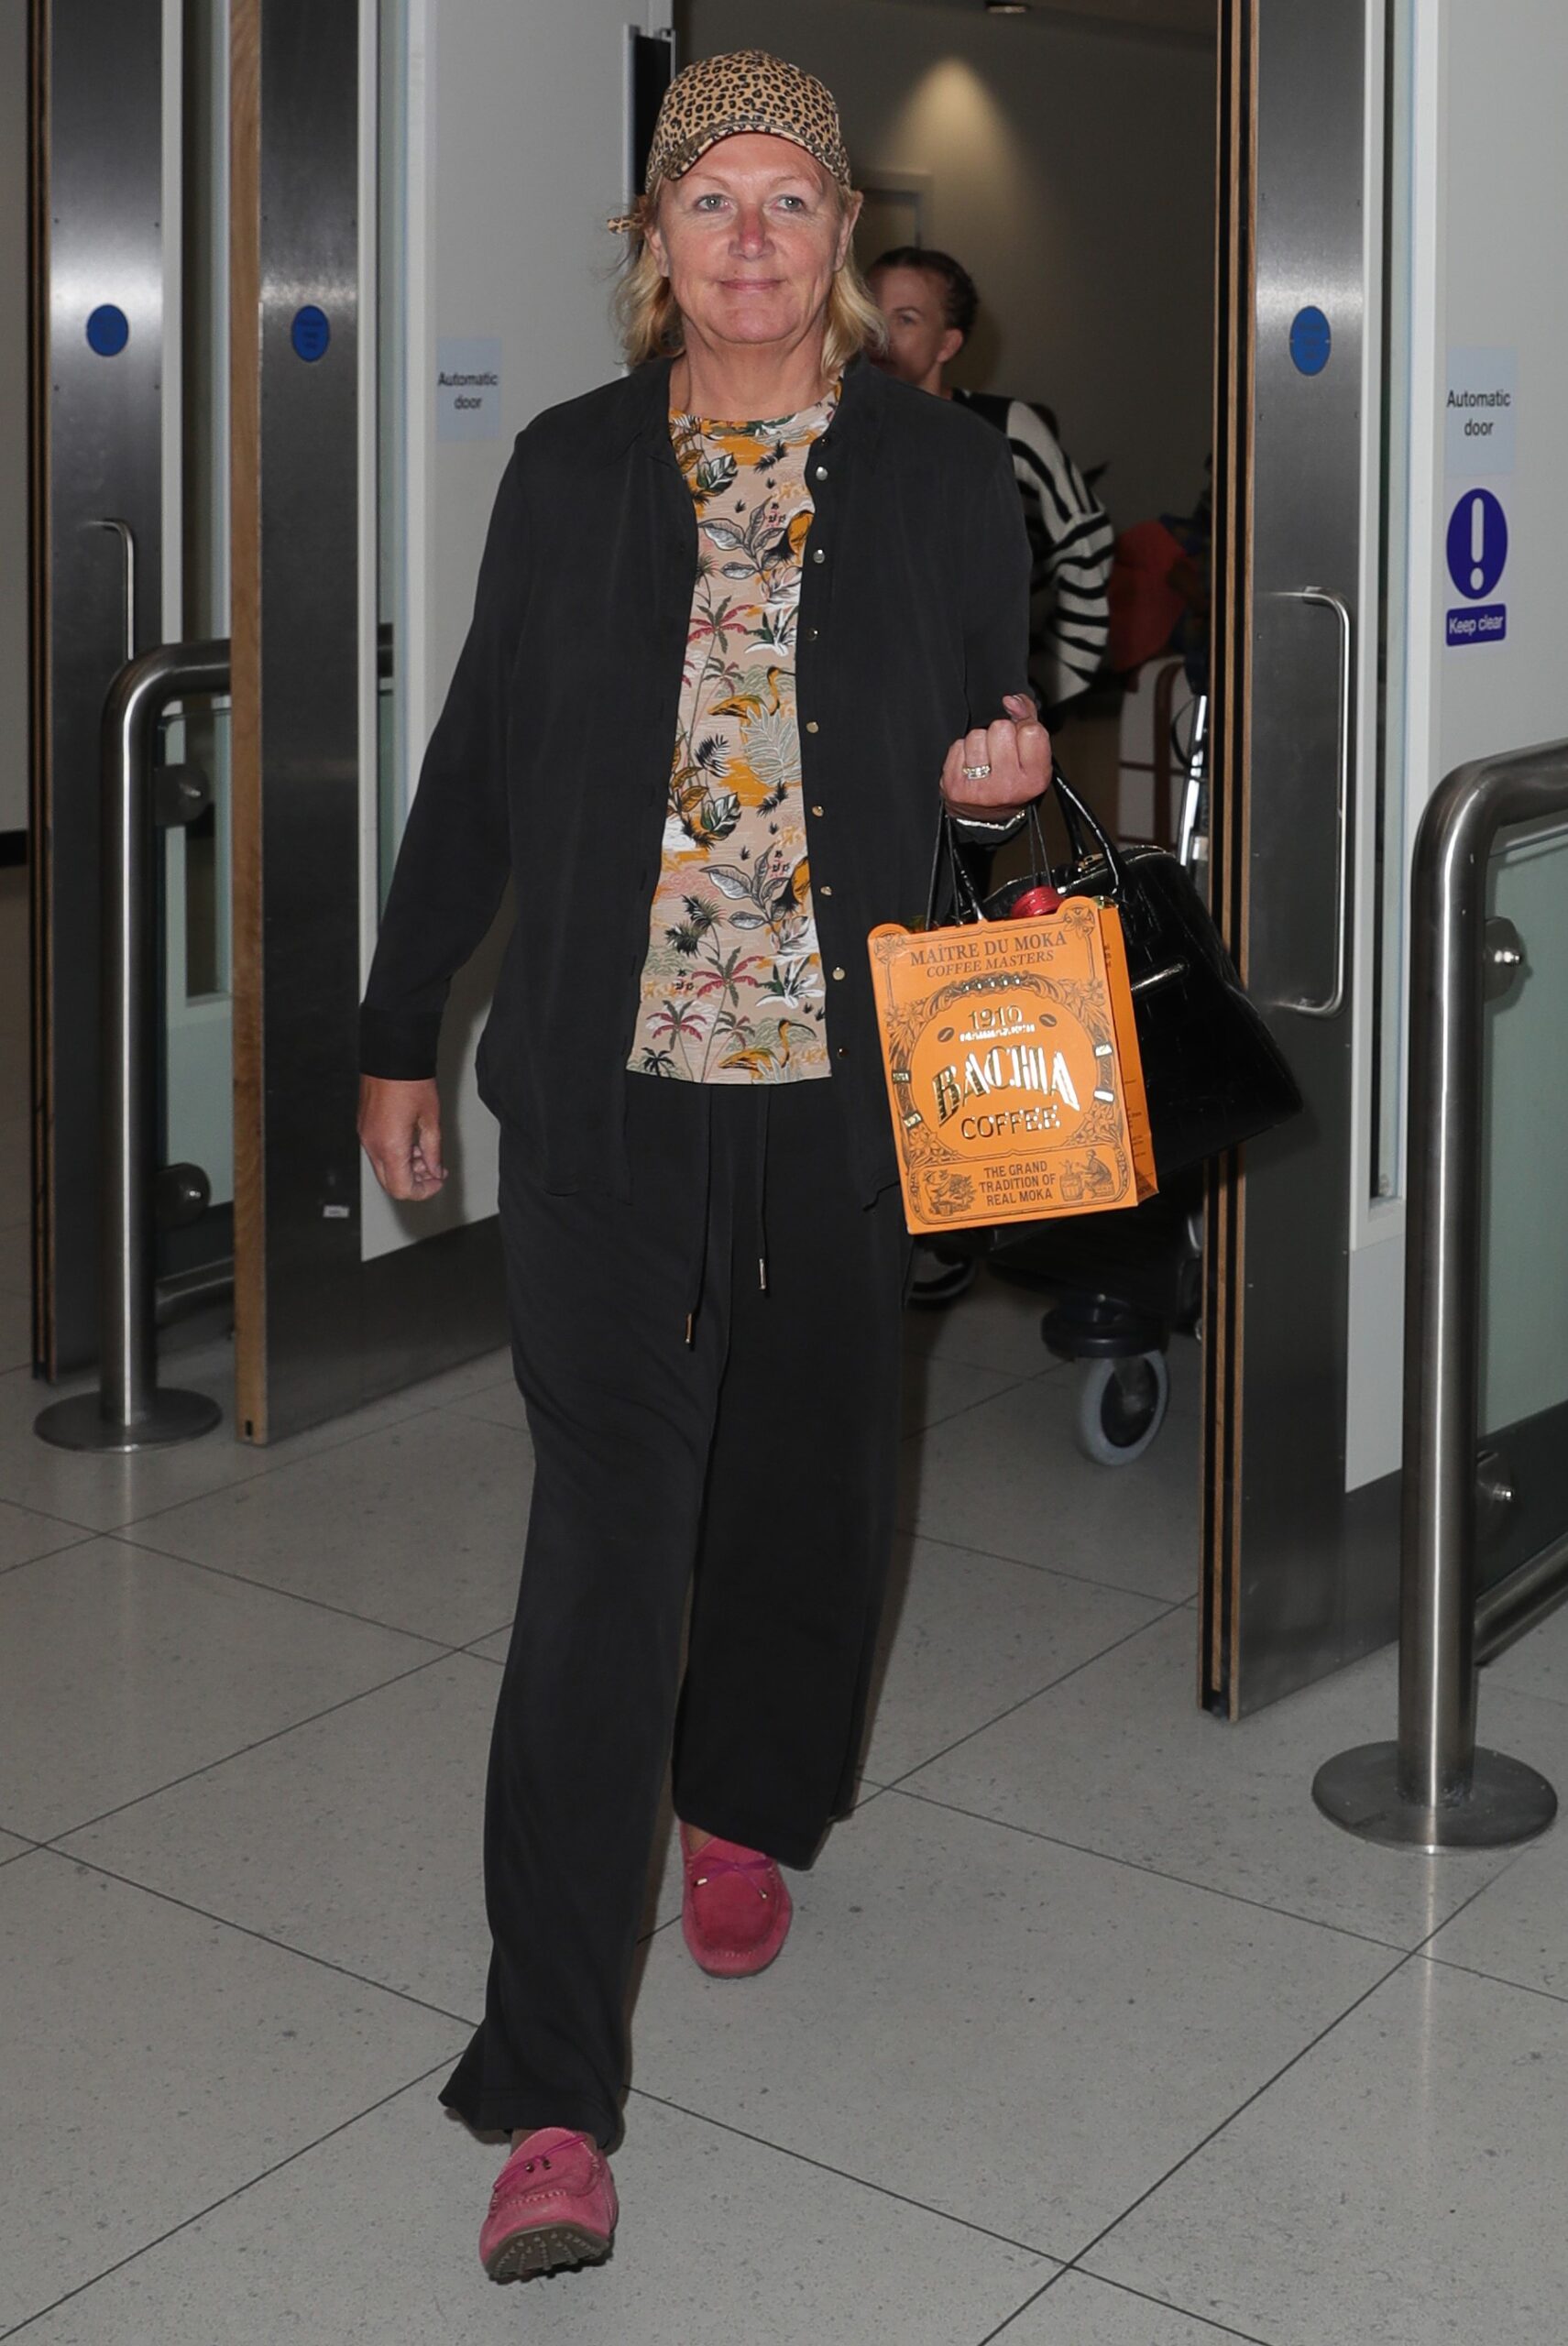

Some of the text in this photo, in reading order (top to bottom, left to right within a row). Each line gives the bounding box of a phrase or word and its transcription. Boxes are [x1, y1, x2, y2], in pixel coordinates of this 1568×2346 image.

[438, 371, 499, 387] Automatic
[454, 394, 482, 410] door
[1446, 389, 1511, 408] Automatic
[1464, 419, 1494, 437] door
[1449, 613, 1504, 636] Keep clear
[910, 930, 1068, 967] MAÎTRE DU MOKA
[927, 949, 1055, 978] COFFEE MASTERS
[968, 1004, 1023, 1030] 1910
[931, 1043, 1080, 1128] BACHA
[960, 1104, 1061, 1141] COFFEE
[983, 1160, 1047, 1178] THE GRAND
[978, 1173, 1056, 1193] TRADITION OF
[986, 1187, 1053, 1207] REAL MOKA
